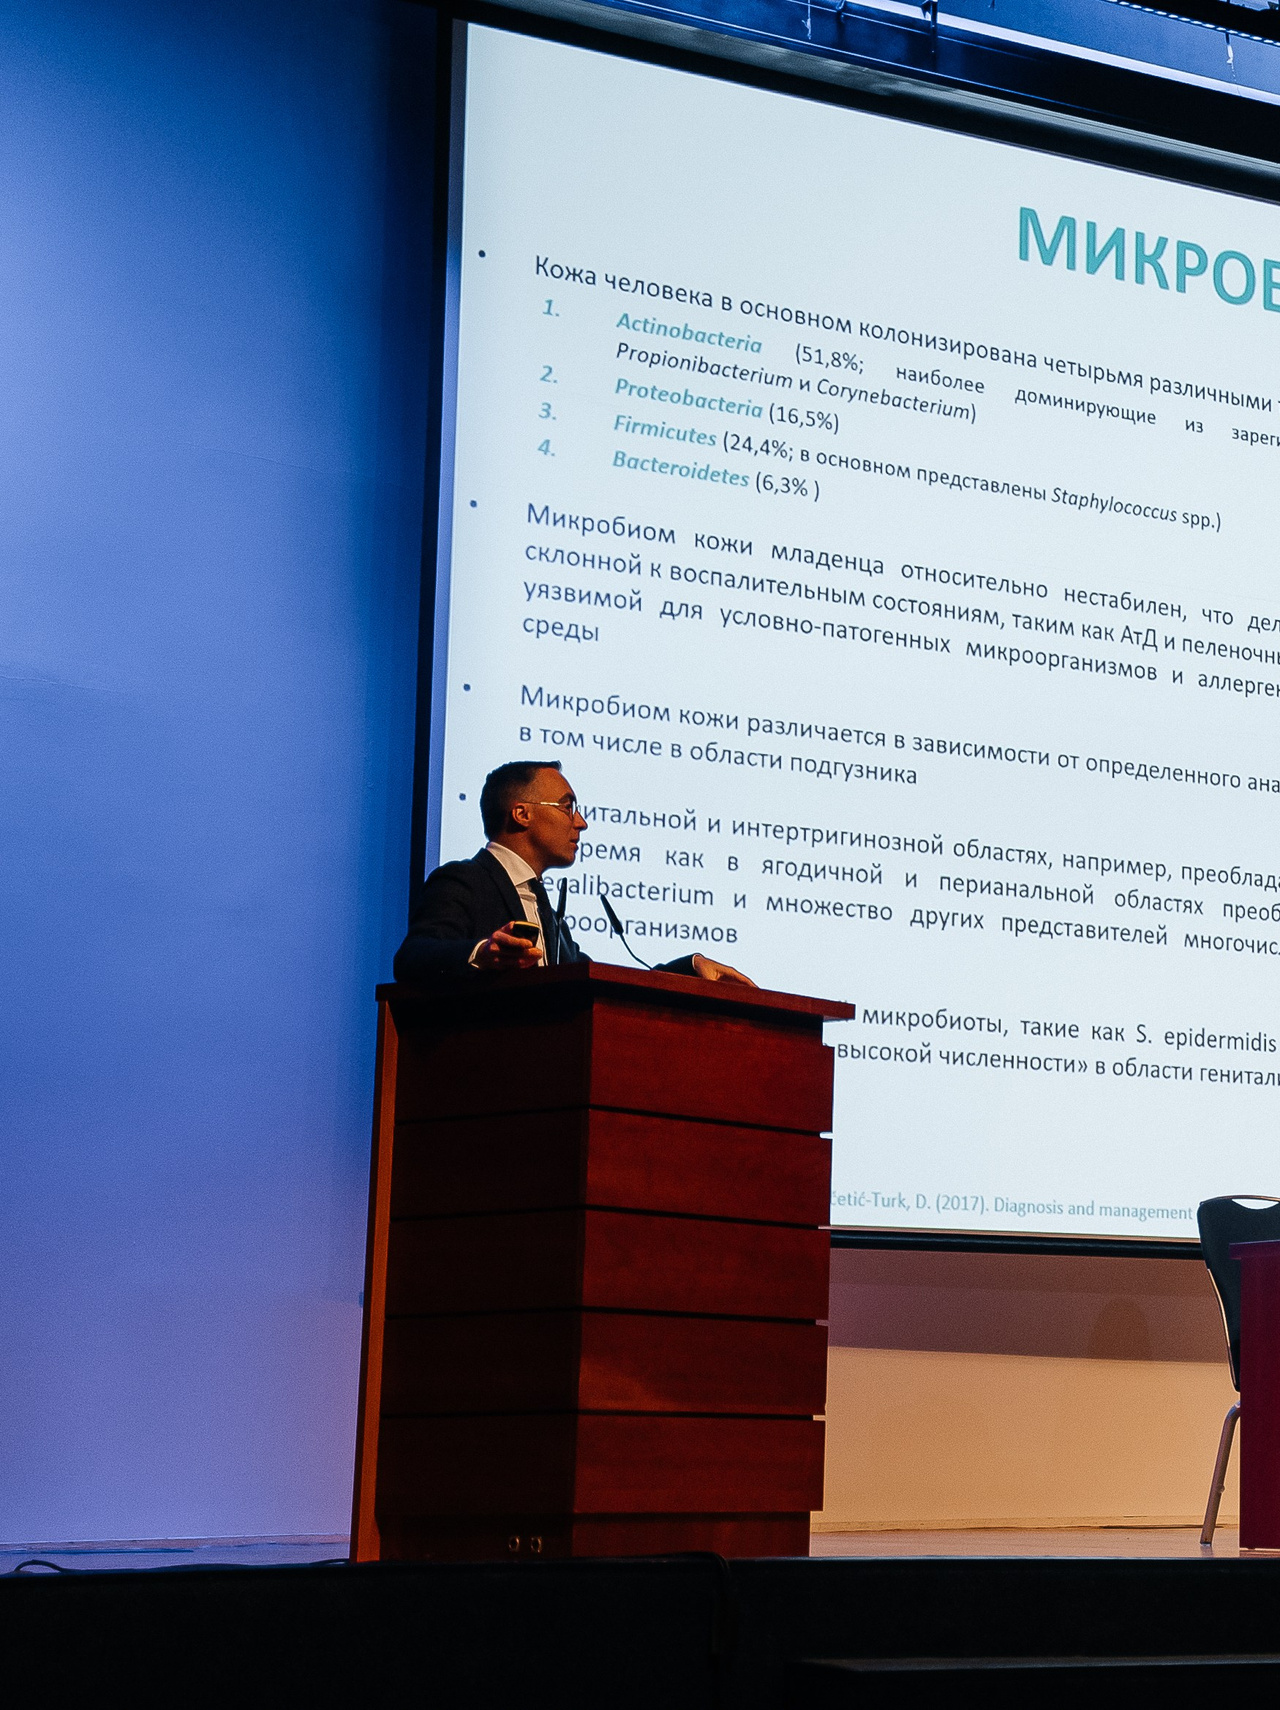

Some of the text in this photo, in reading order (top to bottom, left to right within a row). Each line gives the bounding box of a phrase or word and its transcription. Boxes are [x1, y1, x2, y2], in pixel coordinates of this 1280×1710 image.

[535, 254, 596, 285] Кожа
[604, 272, 712, 307] человека
[739, 299, 851, 334] основном
[859, 321, 1037, 368] колонизирована
[1043, 355, 1143, 388] четырьмя
[1149, 376, 1271, 412] различными
[542, 298, 559, 316] 1.
[615, 312, 762, 353] Actinobacteria
[795, 342, 863, 374] (51,8%;
[896, 366, 984, 394] наиболее
[1014, 388, 1156, 425] доминирующие
[1184, 419, 1203, 433] из
[539, 364, 839, 435] 2. Proteobacteria (16,5%)
[615, 341, 976, 424] Propionibacterium Corynebacterium)
[537, 438, 808, 497] 4. Bacteroidetes (6,3%
[538, 401, 1221, 533] 3. Firmicutes (24,4%; основном представлены Staphylococcus spp.)
[526, 502, 675, 544] Микробиом
[694, 532, 752, 555] кожи
[771, 544, 883, 577] младенца
[900, 563, 1047, 598] относительно
[1063, 587, 1186, 622] нестабилен,
[1201, 607, 1233, 625] что
[522, 617, 598, 643] среды
[523, 580, 642, 611] уязвимой
[658, 600, 702, 620] для
[719, 607, 950, 653] условно-патогенных
[965, 641, 1157, 681] микроорганизмов
[524, 544, 641, 575] склонной
[669, 564, 865, 606] воспалительным
[872, 593, 1005, 630] состояниям,
[1011, 612, 1074, 636] таким
[1081, 623, 1114, 641] как
[1119, 624, 1158, 653] АтД
[520, 684, 670, 722] Микробиом
[679, 708, 738, 730] кожи
[747, 716, 885, 747] различается
[912, 736, 1049, 766] зависимости
[1057, 753, 1079, 769] от
[1085, 757, 1240, 788] определенного
[539, 728, 917, 784] том числе области подгузника
[665, 849, 703, 868] как
[761, 858, 882, 884] ягодичной
[939, 875, 1093, 904] перианальной
[1114, 888, 1203, 915] областях
[732, 820, 943, 855] интертригинозной
[953, 838, 1052, 870] областях,
[1062, 853, 1171, 882] например,
[766, 895, 892, 921] множество
[909, 908, 984, 930] других
[1001, 916, 1167, 945] представителей
[837, 1041, 931, 1064] высокой
[938, 1049, 1087, 1073] численности»
[1112, 1056, 1192, 1080] области
[862, 1007, 1008, 1037] микробиоты,
[1019, 1019, 1079, 1038] такие
[1091, 1025, 1124, 1042] как
[1135, 1023, 1152, 1043] S.
[1163, 1027, 1276, 1052] epidermidis
[915, 1192, 1192, 1222] D. (2017). Diagnosis and management
